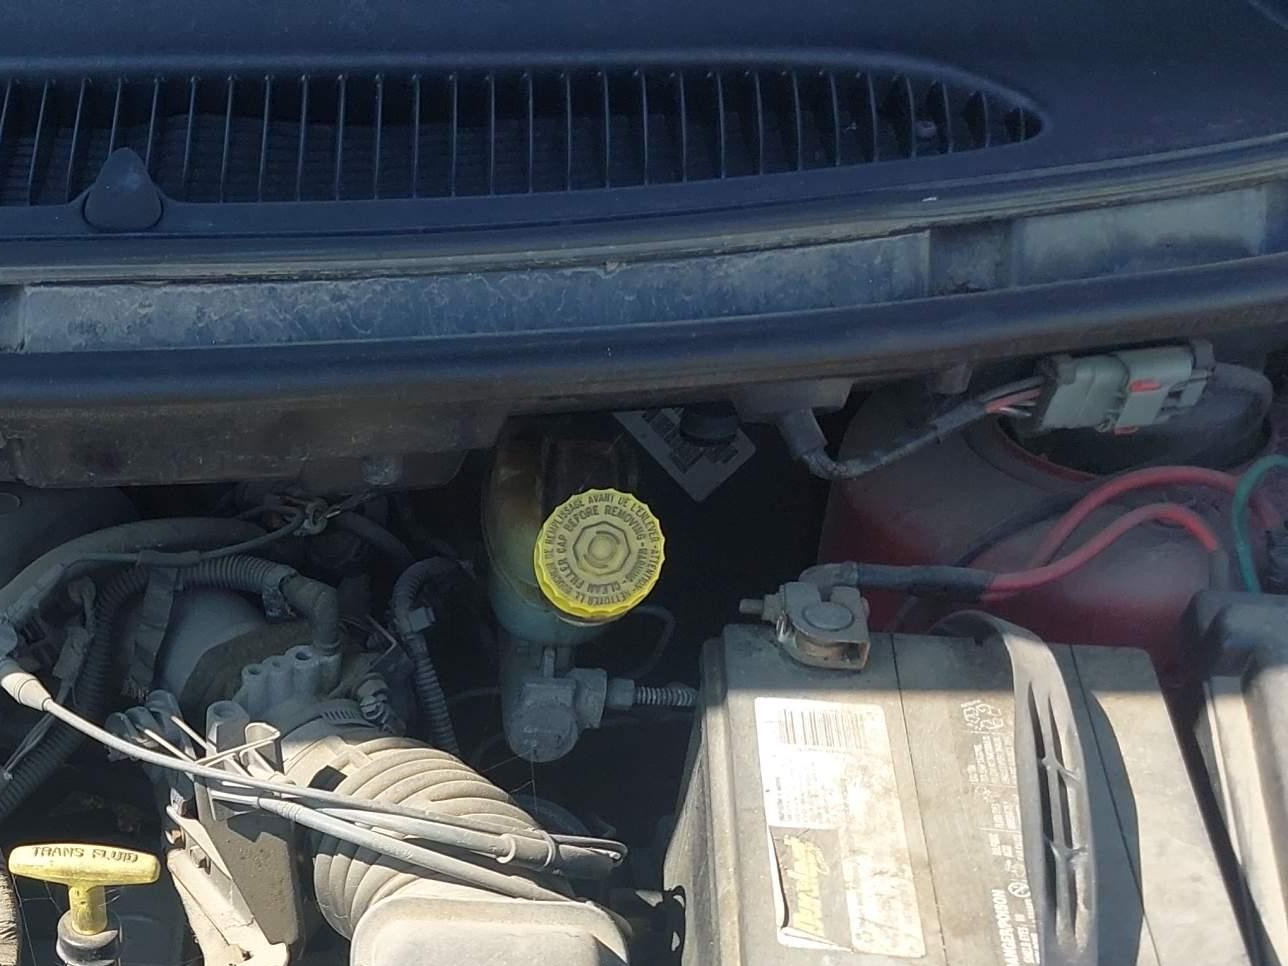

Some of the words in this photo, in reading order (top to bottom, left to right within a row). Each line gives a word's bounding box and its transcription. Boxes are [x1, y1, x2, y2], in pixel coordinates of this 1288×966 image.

[587, 493, 614, 504] AVANT
[617, 495, 629, 507] DE
[564, 504, 600, 532] BEFORE
[604, 504, 646, 541] REMOVING
[556, 534, 568, 554] CAP
[557, 558, 585, 589] FILLER
[587, 583, 621, 594] CLEAN
[32, 846, 85, 857] TRANS
[92, 848, 139, 863] FLUID
